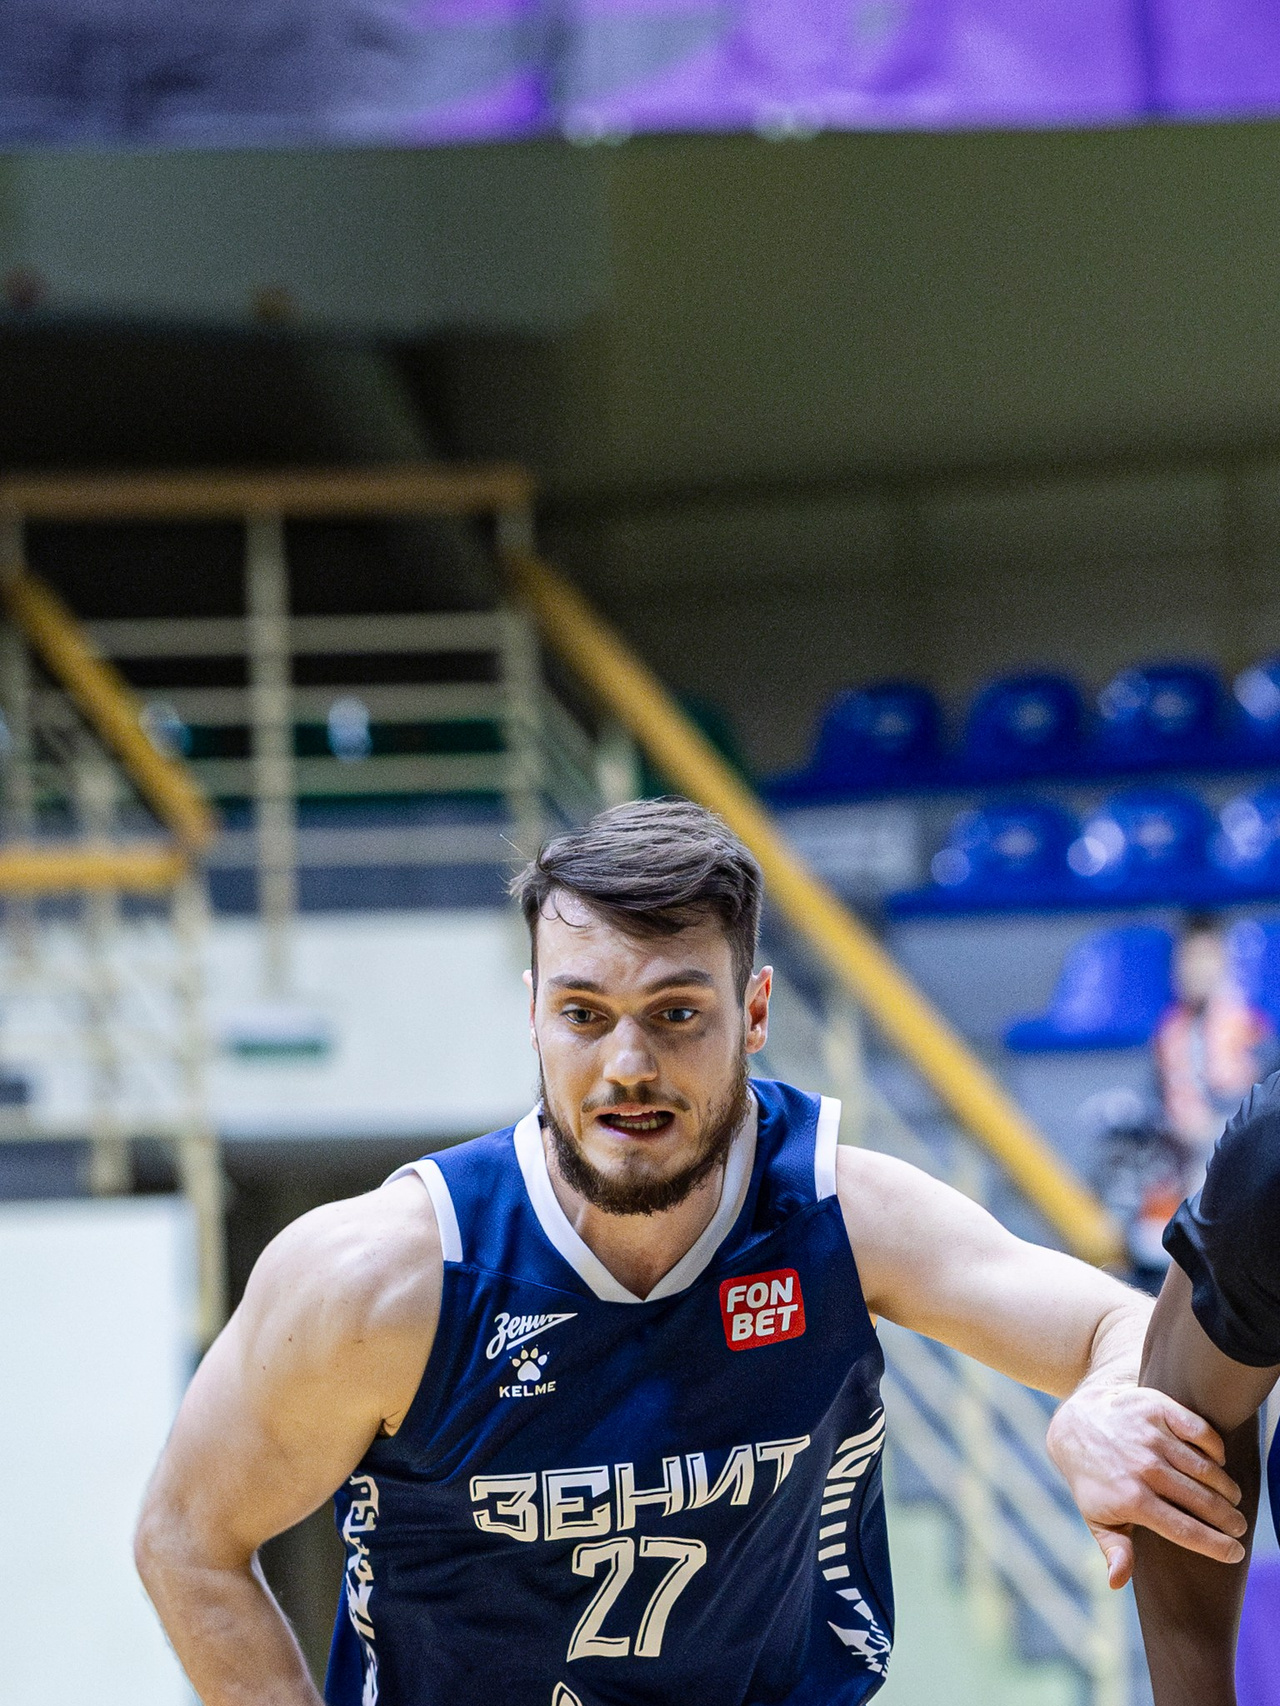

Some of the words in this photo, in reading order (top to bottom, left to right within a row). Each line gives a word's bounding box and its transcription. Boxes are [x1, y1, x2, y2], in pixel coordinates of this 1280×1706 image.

[726, 1276, 794, 1313] FON
[730, 1304, 798, 1342] BET
[499, 1381, 556, 1398] KELME
[469, 1434, 811, 1542] ЗЕНИТ
[567, 1536, 707, 1663] 27
